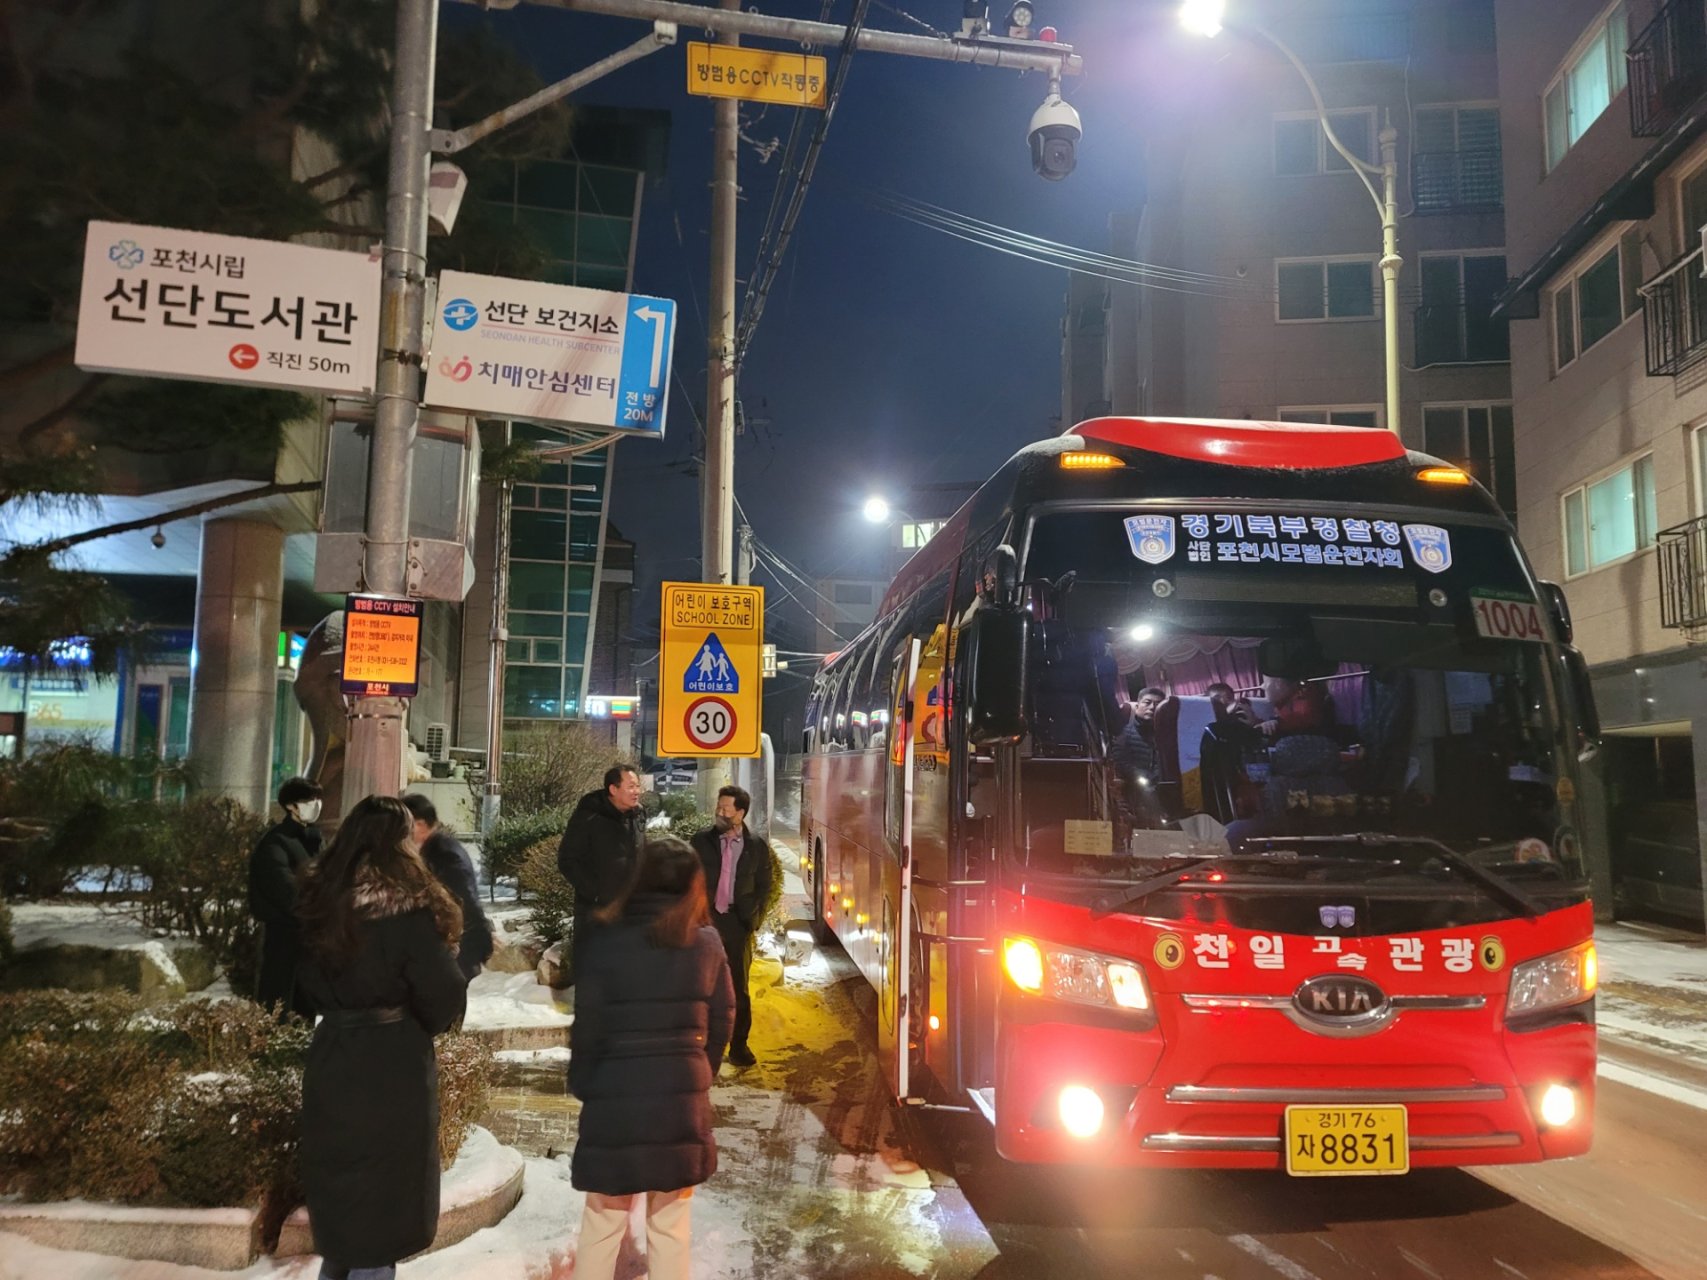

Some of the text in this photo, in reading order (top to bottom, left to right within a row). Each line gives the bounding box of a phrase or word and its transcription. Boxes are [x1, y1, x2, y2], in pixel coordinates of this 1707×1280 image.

[697, 63, 820, 93] 방범용CCTV작동중
[150, 248, 246, 279] 포천시립
[104, 278, 358, 345] 선단도서관
[485, 300, 620, 335] 선단 보건지소
[480, 329, 621, 355] SEONDAN HEALTH SUBCENTER
[266, 351, 350, 374] 직진 50m
[478, 361, 617, 400] 치매안심센터
[623, 408, 654, 422] 20M
[1180, 514, 1401, 545] 경기북부경찰청
[1217, 541, 1404, 569] 포천시모범운전자회
[374, 602, 392, 611] CCTV
[675, 593, 752, 612] 어린이 보호구역
[676, 611, 750, 626] SCHOOL ZONE
[1478, 600, 1544, 640] 1004
[688, 682, 734, 692] 어린이보호
[696, 711, 726, 734] 30
[1312, 987, 1371, 1012] KIA
